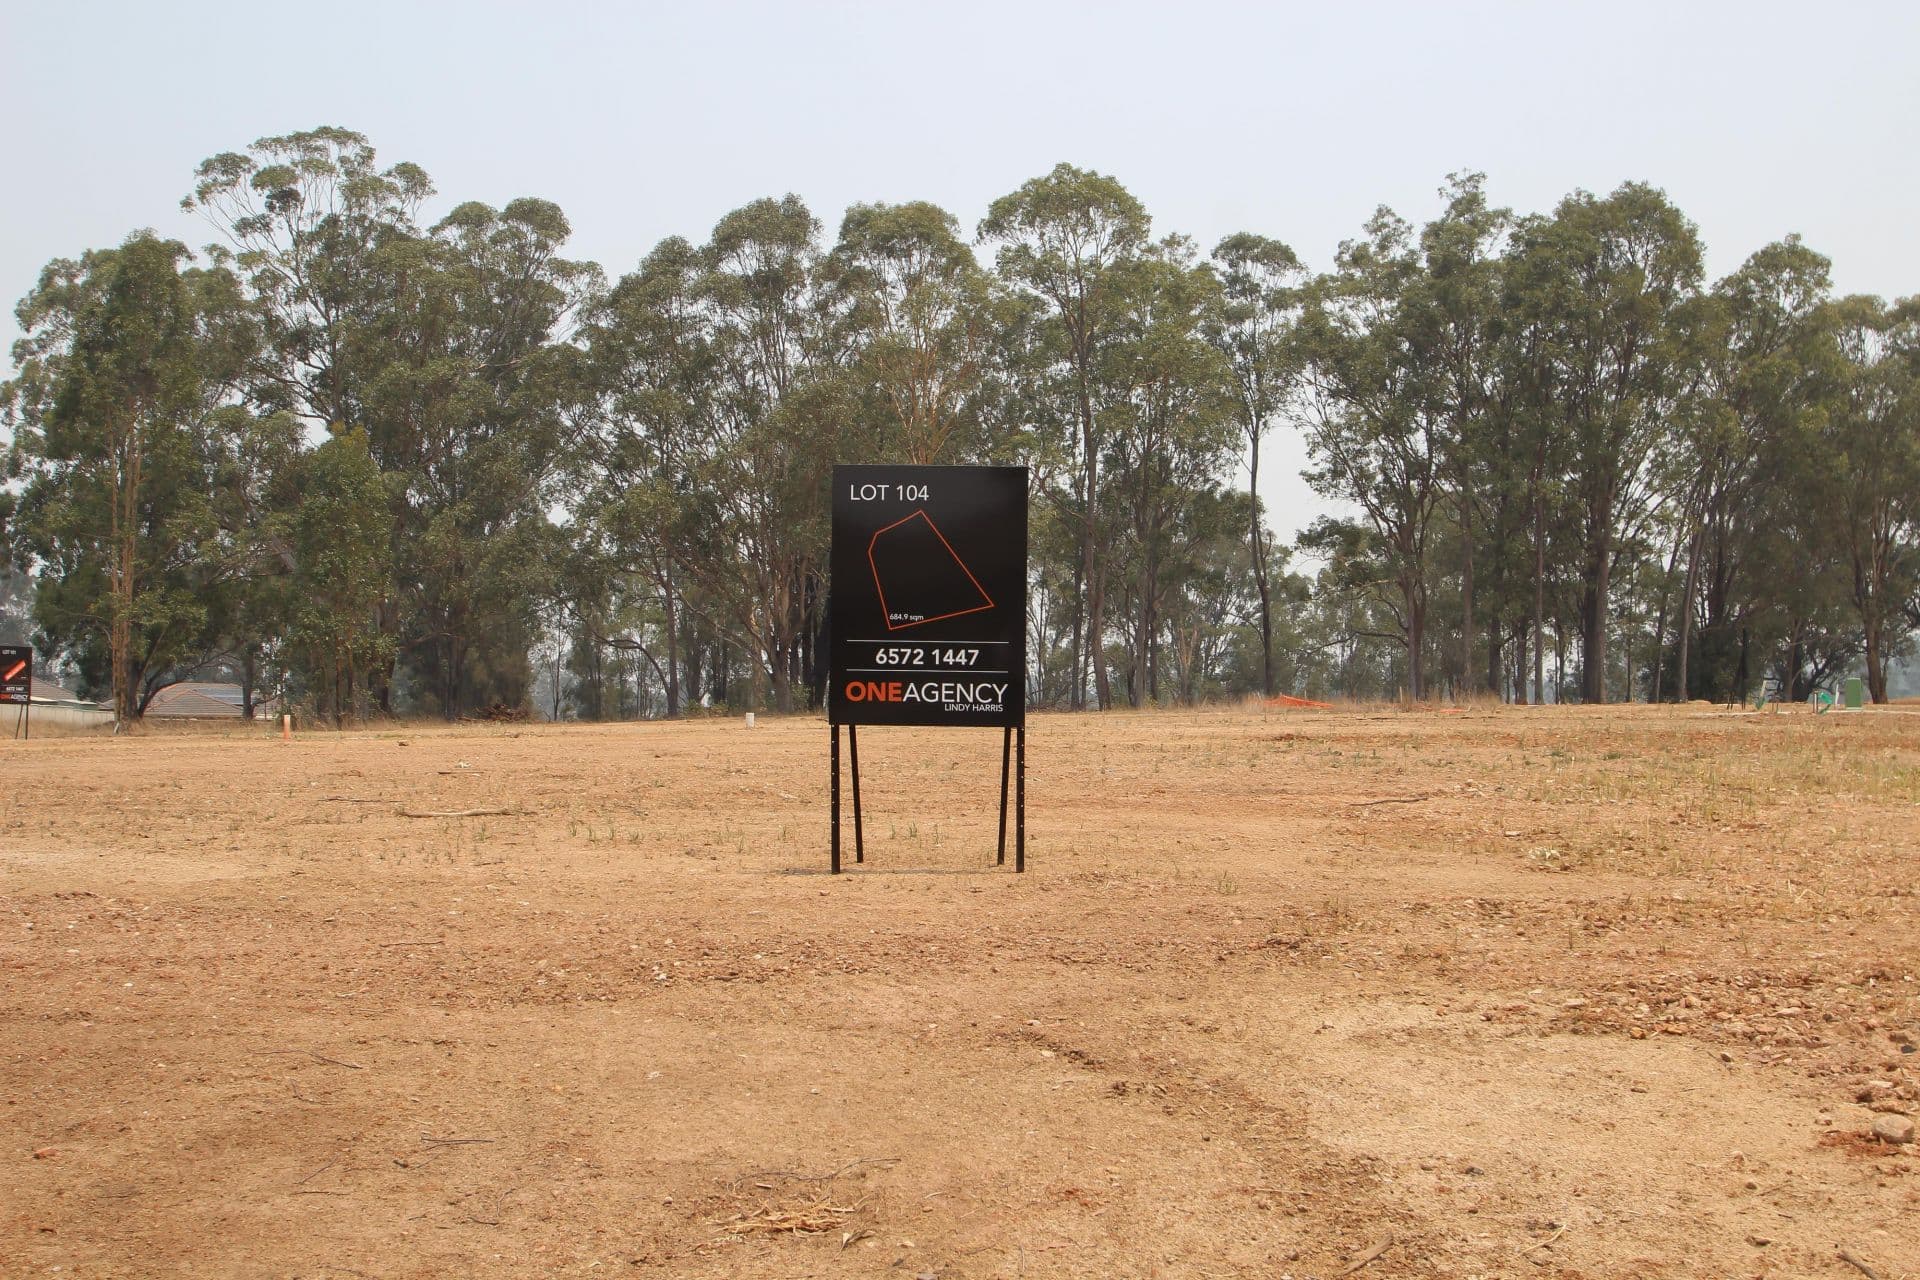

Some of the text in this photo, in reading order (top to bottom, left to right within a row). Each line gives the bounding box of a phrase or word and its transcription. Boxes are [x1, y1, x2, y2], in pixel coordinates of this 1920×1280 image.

[850, 484, 930, 501] LOT 104
[889, 613, 924, 622] 684.9 sqm
[875, 648, 980, 666] 6572 1447
[944, 704, 1003, 712] LINDY HARRIS
